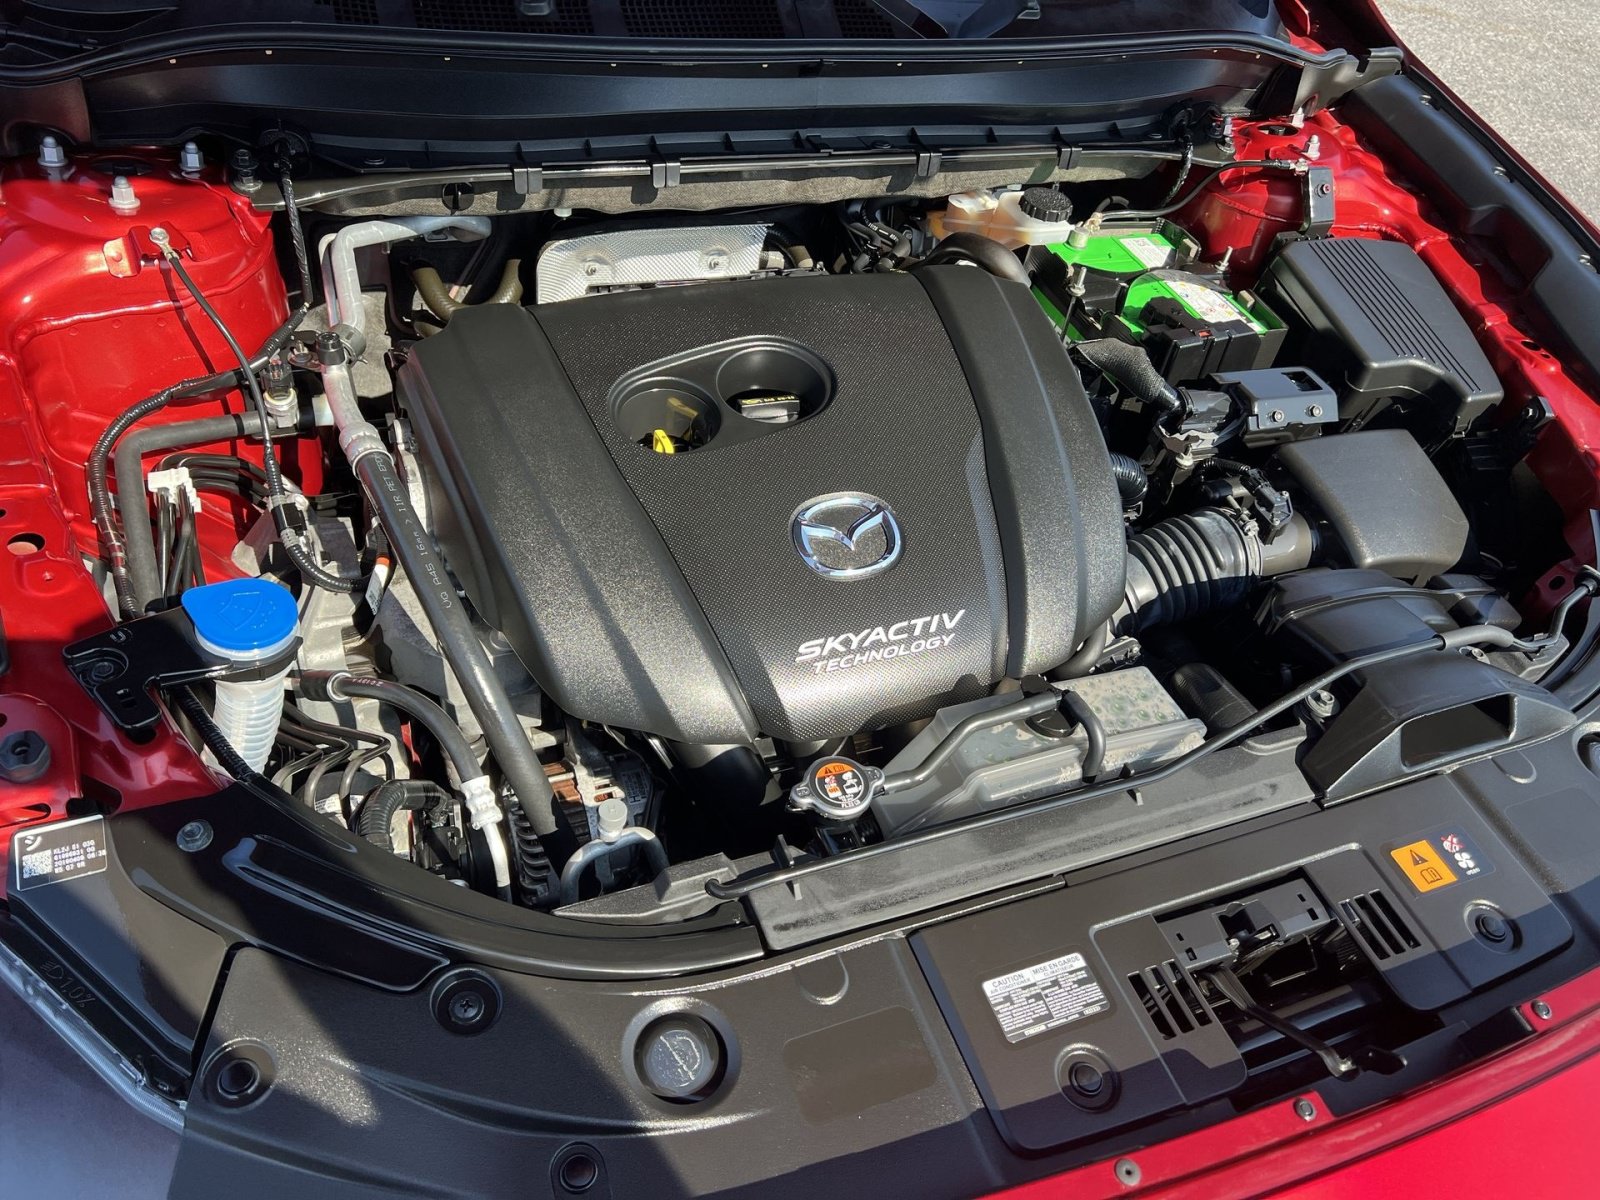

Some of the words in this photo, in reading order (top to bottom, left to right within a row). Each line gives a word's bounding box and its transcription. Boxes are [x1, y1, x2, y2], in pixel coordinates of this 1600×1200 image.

[795, 609, 966, 663] SKYACTIV
[813, 633, 956, 675] TECHNOLOGY
[1032, 965, 1048, 974] MISE
[1048, 962, 1058, 970] EN
[1058, 955, 1080, 966] GARDE
[992, 973, 1024, 988] CAUTION
